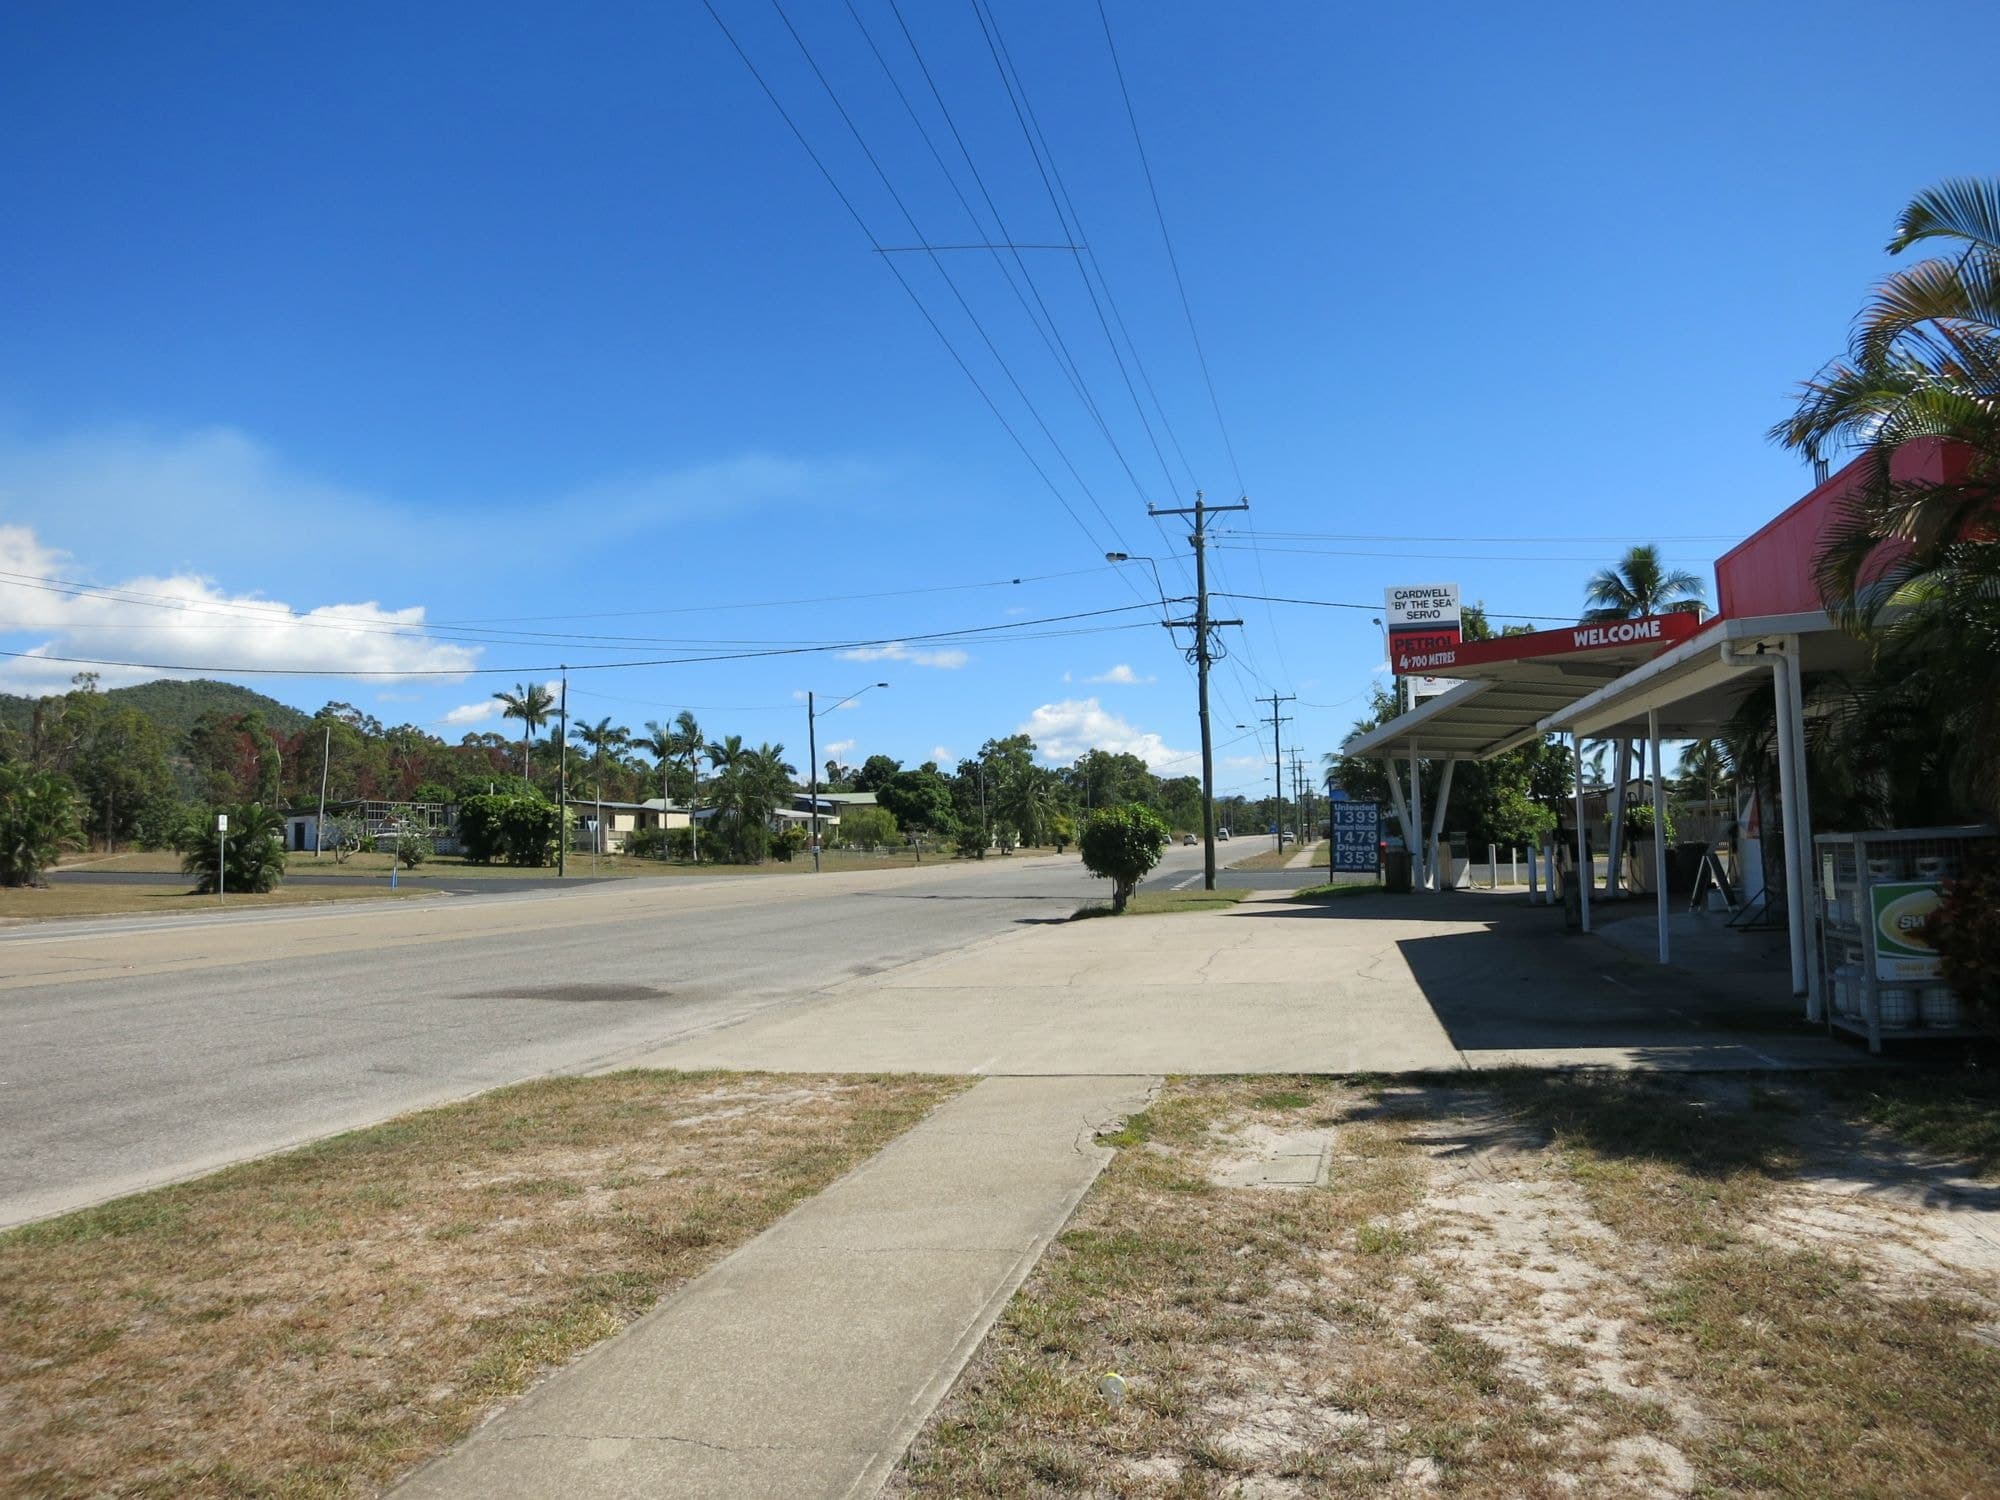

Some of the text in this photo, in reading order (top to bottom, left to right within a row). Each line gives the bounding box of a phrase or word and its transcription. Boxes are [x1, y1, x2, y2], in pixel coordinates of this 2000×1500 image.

[1394, 588, 1450, 599] CARDWELL
[1410, 600, 1430, 609] THE
[1406, 610, 1441, 620] SERVO
[1573, 620, 1660, 647] WELCOME
[1428, 651, 1456, 666] METRES
[1336, 843, 1375, 851] Diesel
